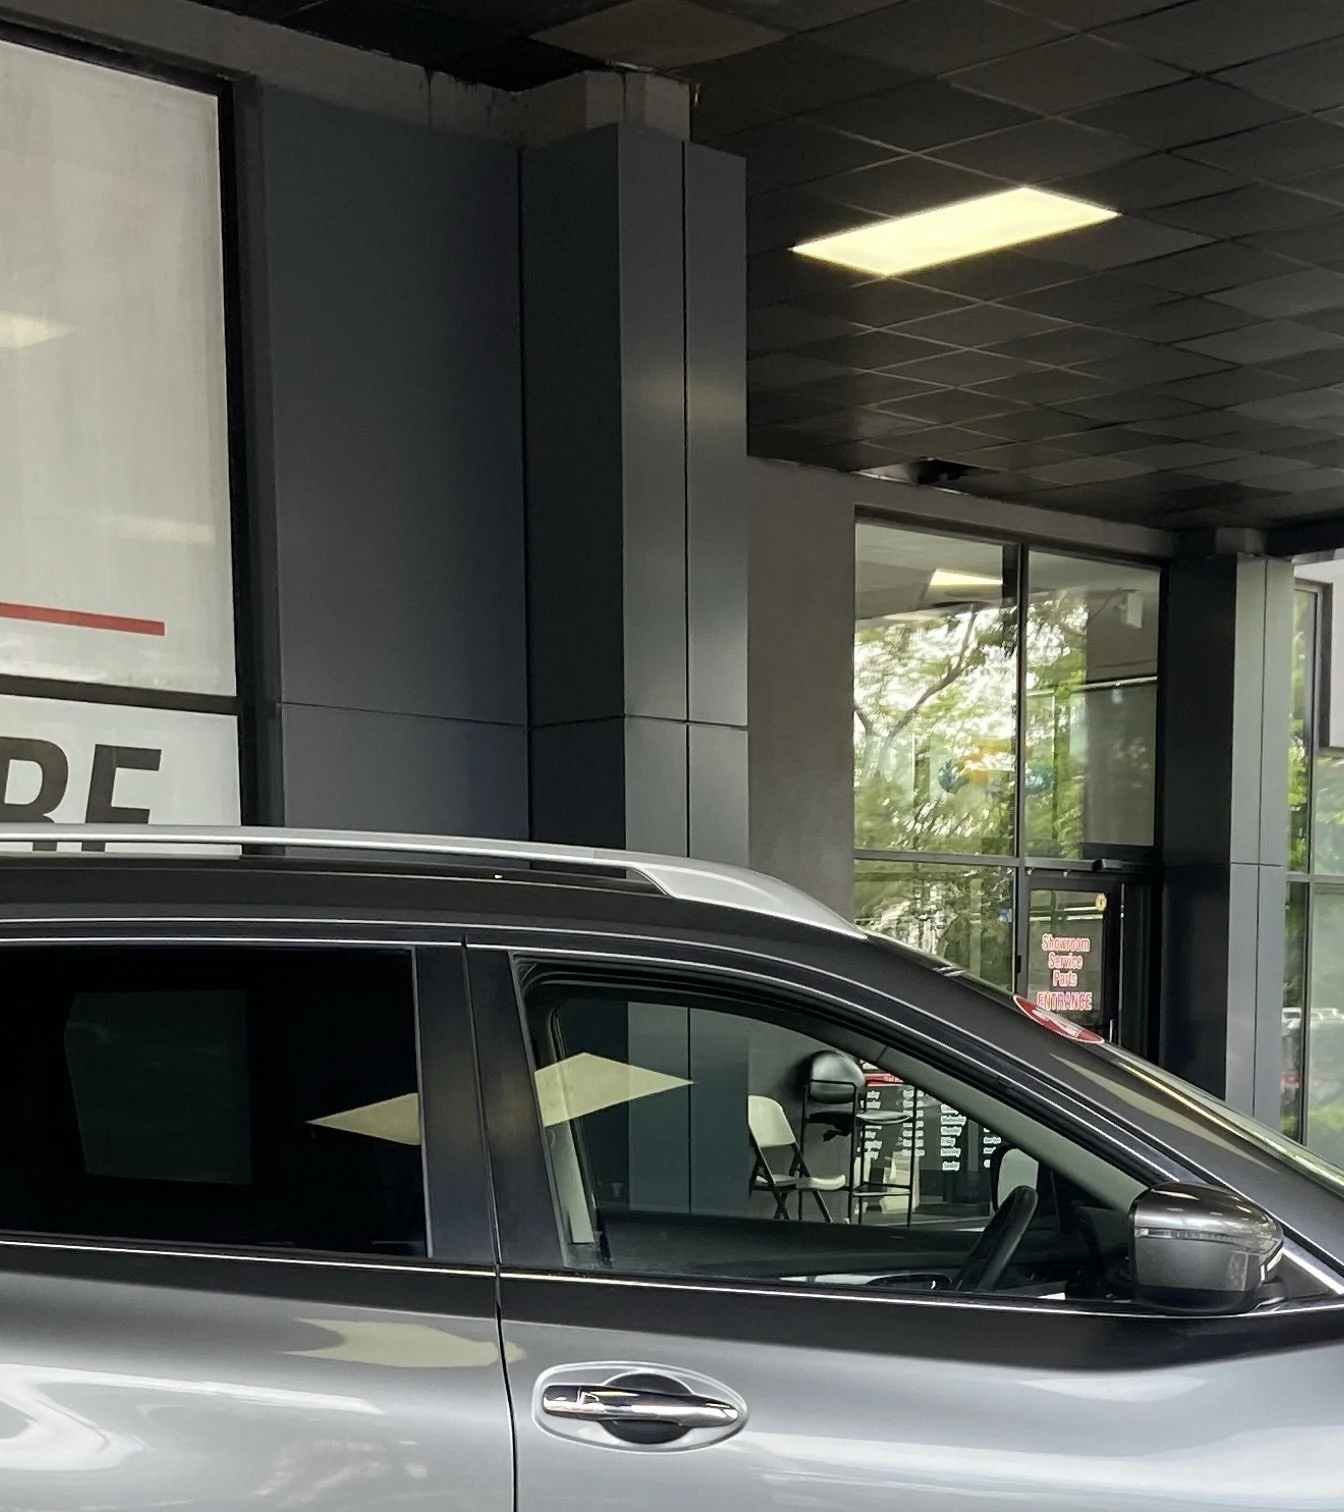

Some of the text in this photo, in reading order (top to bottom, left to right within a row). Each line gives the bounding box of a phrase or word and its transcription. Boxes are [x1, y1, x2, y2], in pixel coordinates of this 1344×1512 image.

[1041, 933, 1091, 953] Showroom
[1047, 951, 1084, 970] Service
[1052, 969, 1078, 987] Parts
[1036, 991, 1093, 1012] ENTRANCE
